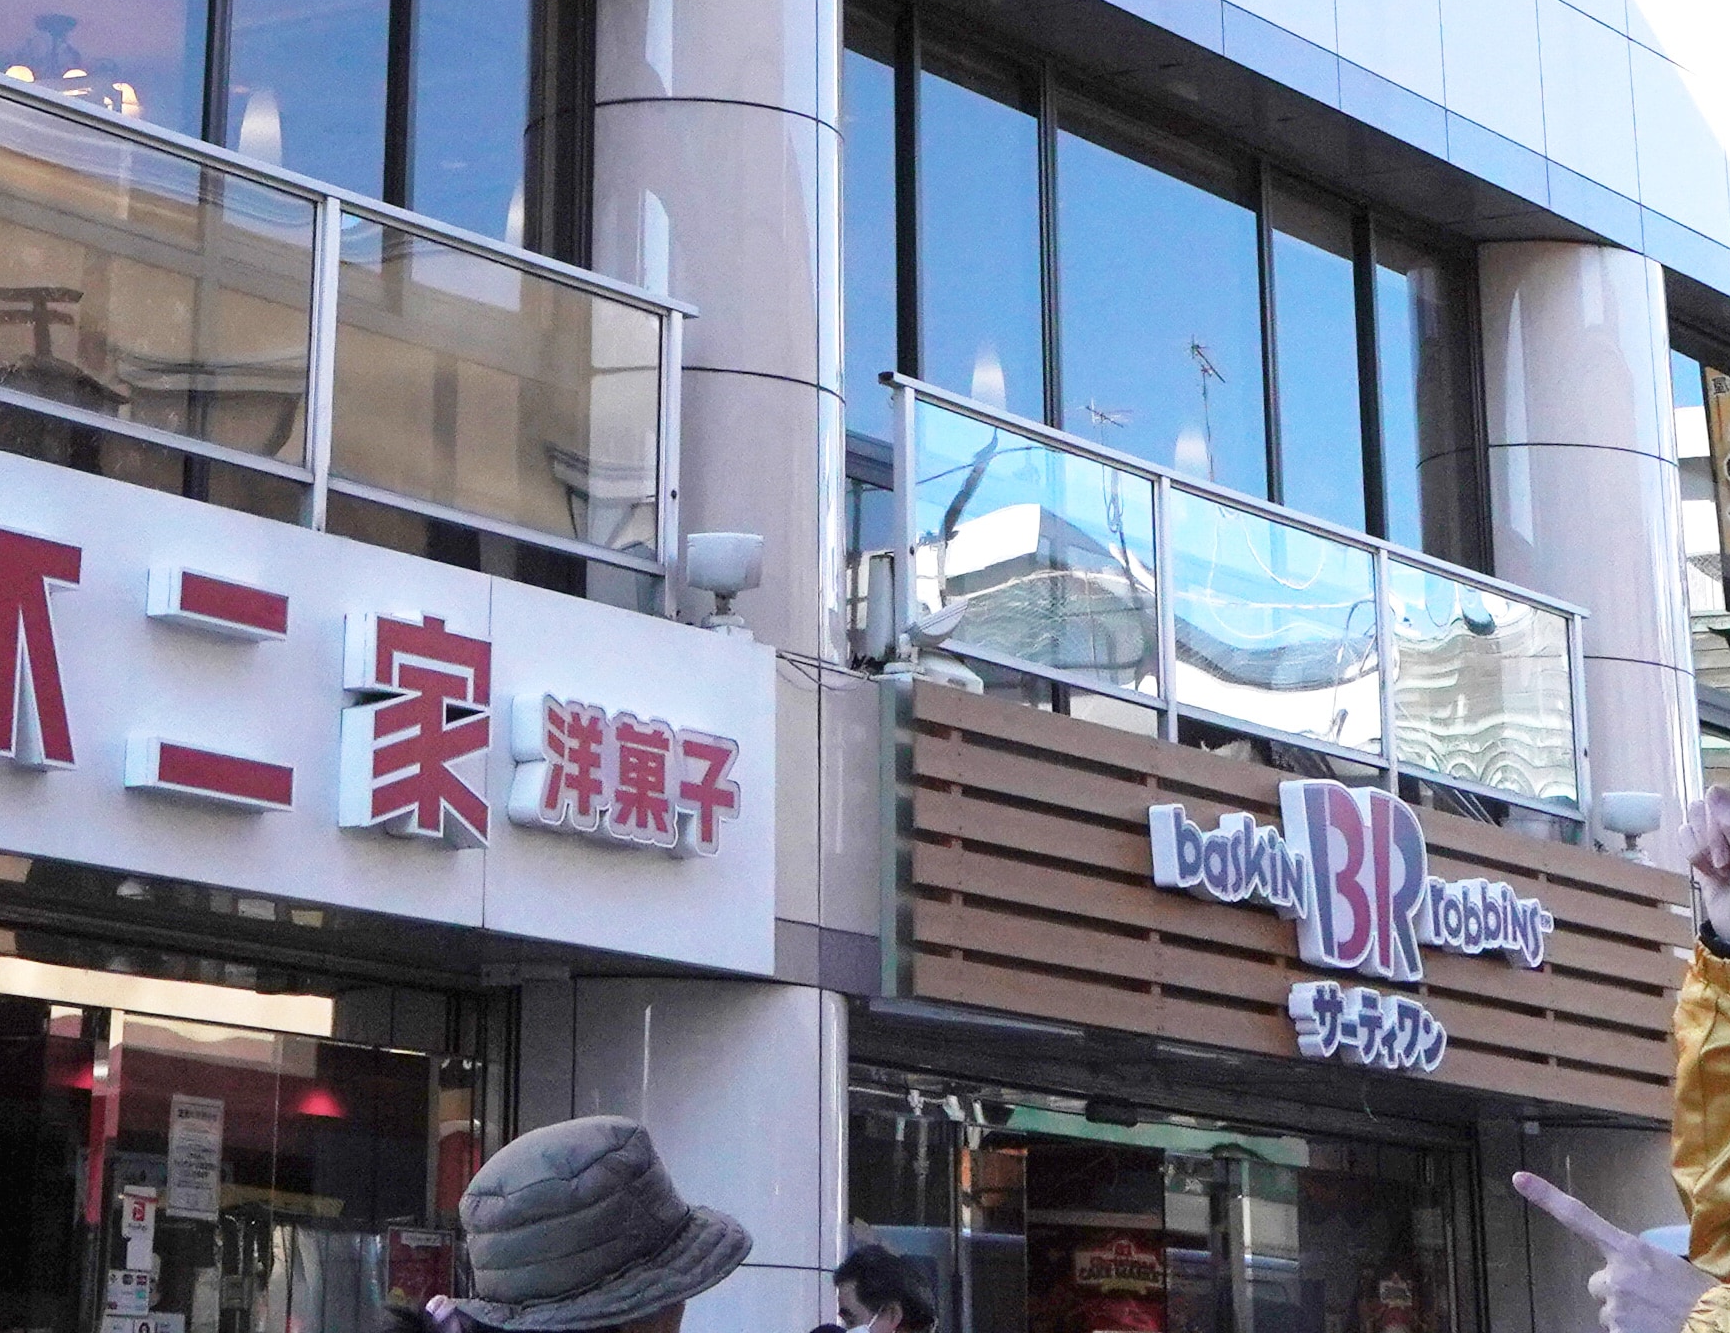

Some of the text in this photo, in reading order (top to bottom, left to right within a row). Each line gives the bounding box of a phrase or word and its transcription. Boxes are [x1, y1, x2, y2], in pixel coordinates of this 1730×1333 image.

[545, 700, 742, 853] 洋菓子
[1303, 783, 1427, 980] BR
[1312, 983, 1447, 1071] サーティワン
